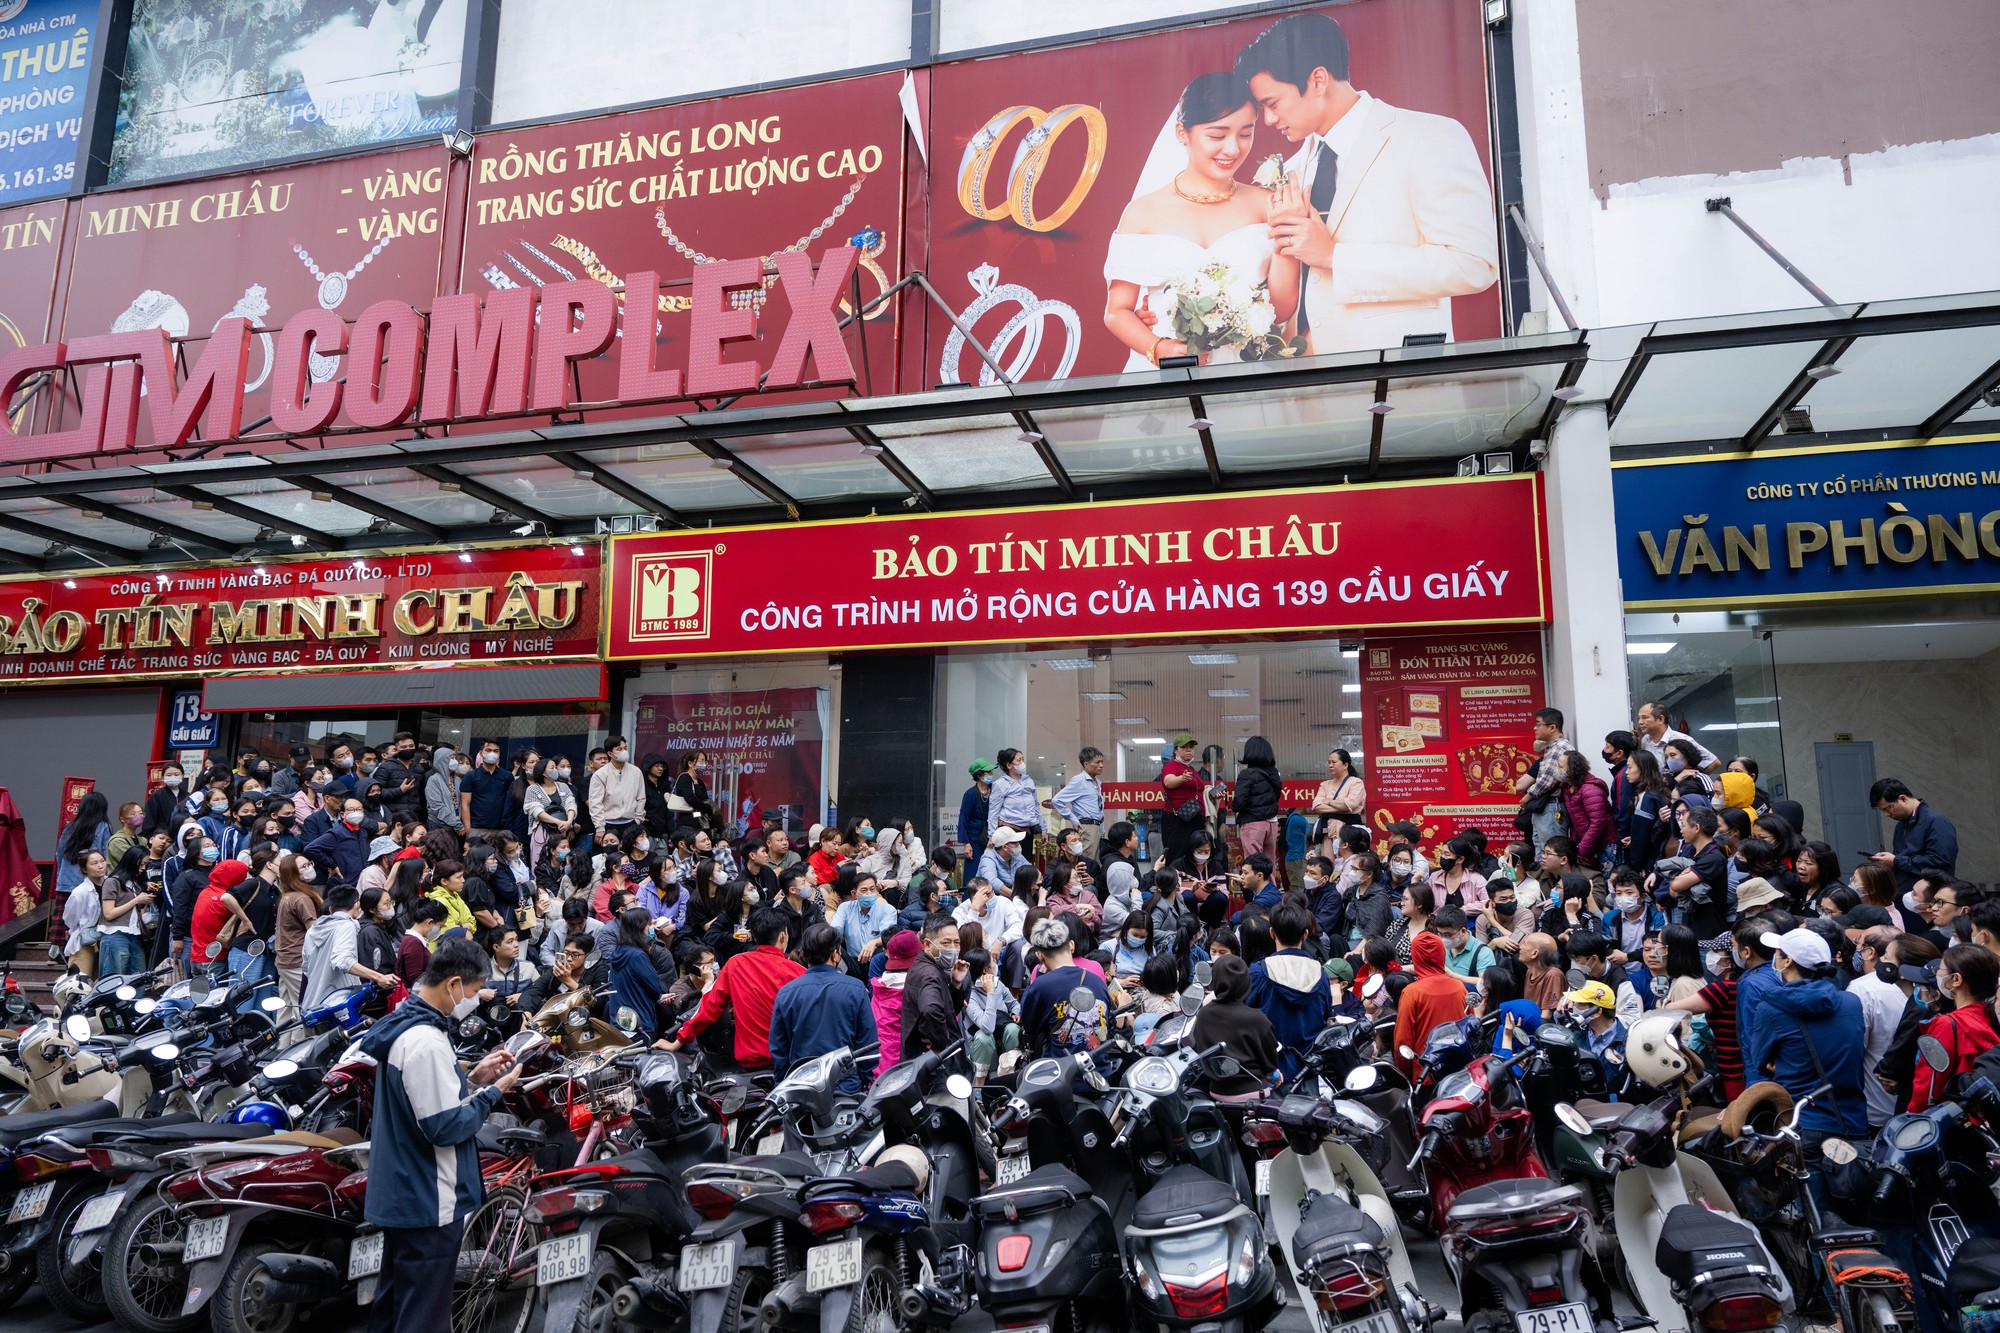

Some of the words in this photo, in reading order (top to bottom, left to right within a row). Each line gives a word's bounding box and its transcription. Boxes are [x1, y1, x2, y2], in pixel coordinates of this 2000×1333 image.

[19, 18, 46, 36] NHÀ
[50, 14, 77, 29] CTM
[2, 27, 89, 82] THUÊ
[0, 85, 75, 115] PHÒNG
[288, 88, 399, 127] FOREVER
[0, 123, 49, 152] DỊCH
[56, 117, 82, 142] VỤ
[479, 142, 567, 185] RỒNG
[574, 130, 681, 171] THĂNG
[690, 115, 782, 155] LONG
[363, 167, 443, 203] VÀNG
[477, 189, 563, 226] TRANG
[569, 176, 624, 214] SỨC
[628, 158, 704, 205] CHẤT
[708, 151, 810, 197] LƯỢNG
[816, 145, 883, 178] CAO
[2, 216, 58, 251] TÍN
[85, 198, 183, 239] MINH
[189, 180, 294, 223] CHÂU
[358, 206, 439, 242] VÀNG
[270, 244, 861, 436] COMPLEX
[1746, 482, 1793, 501] CÔNG
[1796, 482, 1819, 497] TY
[1822, 474, 1848, 495] CỔ
[1850, 473, 1899, 495] PHẦN
[1901, 471, 1978, 491] THƯƠNG
[872, 535, 959, 580] BẢO
[969, 533, 1049, 576] TÍN
[1058, 531, 1193, 570] MINH
[1202, 514, 1343, 562] CHÂU
[1637, 513, 1770, 576] VĂN
[109, 580, 151, 596] CÔNG
[156, 578, 174, 593] TY
[178, 577, 216, 592] TNHH
[219, 571, 259, 589] VÀNG
[262, 572, 293, 588] BẠC
[298, 567, 319, 584] ĐÁ
[323, 566, 354, 583] QUÝ
[356, 566, 393, 583] (CO.,
[398, 562, 433, 579] LTD)
[740, 601, 823, 633] CÔNG
[831, 591, 921, 627] TRÌNH
[931, 588, 979, 623] MỞ
[987, 588, 1078, 622] RỘNG
[1087, 579, 1156, 616] CỬA
[1166, 578, 1261, 612] HÀNG
[1272, 579, 1329, 607] 139
[1338, 565, 1412, 605] CẦU
[1422, 560, 1510, 600] GIẤY
[95, 593, 202, 651] TÍN
[206, 592, 385, 646] MINH
[393, 571, 586, 636] CHÂU
[640, 620, 671, 633] BTMC
[673, 619, 700, 632] 1989
[28, 660, 75, 674] DOANH
[78, 653, 106, 672] CHẾ
[110, 655, 137, 671] TÁC
[142, 655, 189, 669] TRANG
[193, 651, 223, 667] SỨC
[231, 650, 269, 665] VÀNG
[272, 650, 301, 664] BẠC
[315, 646, 335, 662] ĐÁ
[338, 646, 368, 661] QUÝ
[388, 644, 415, 659] KIM
[419, 642, 471, 657] CƯƠNG
[485, 638, 509, 654] MỸ
[513, 636, 555, 655] NGHỆ
[1425, 645, 1458, 654] TRANG
[1460, 643, 1479, 653] SỨC
[1481, 642, 1508, 652] VÀNG
[1400, 655, 1429, 669] ĐÓN
[1432, 653, 1471, 668] THẦN
[1474, 653, 1497, 666] TÀI
[1500, 653, 1536, 665] 2026
[1401, 672, 1416, 680] SẮM
[1417, 671, 1437, 680] VÀNG
[1438, 670, 1458, 679] THẦN
[1459, 670, 1471, 678] TÀI
[1476, 670, 1491, 678] LỘC
[1521, 668, 1537, 676] CỬA
[691, 703, 706, 718] LỄ
[709, 705, 743, 717] TRAO
[745, 702, 772, 716] GIẢI
[191, 725, 212, 741] GIẤY
[667, 720, 694, 733] BỐC
[697, 718, 732, 732] THĂM
[735, 718, 763, 730] MAY
[765, 714, 795, 729] MẮN
[666, 736, 698, 750] MỪNG
[699, 736, 724, 749] SINH
[726, 733, 753, 749] NHẬT
[756, 736, 768, 748] 36
[771, 732, 796, 746] NĂM
[706, 751, 721, 760] TÍN
[749, 749, 775, 760] CHÂU
[1002, 1157, 1028, 1174] 29-X1
[19, 1183, 49, 1204] 29-Y1
[9, 1199, 46, 1220] 082.55
[191, 1218, 223, 1241] 29-Y3
[185, 1236, 223, 1260] 548.16
[546, 1236, 581, 1261] 29-P1
[688, 1244, 726, 1268] 29-C1
[1705, 1251, 1746, 1261] HONDA
[540, 1255, 587, 1283] 808.98
[683, 1264, 729, 1289] 141.70
[810, 1262, 857, 1289] 014.58
[1921, 1272, 1946, 1288] HONDA
